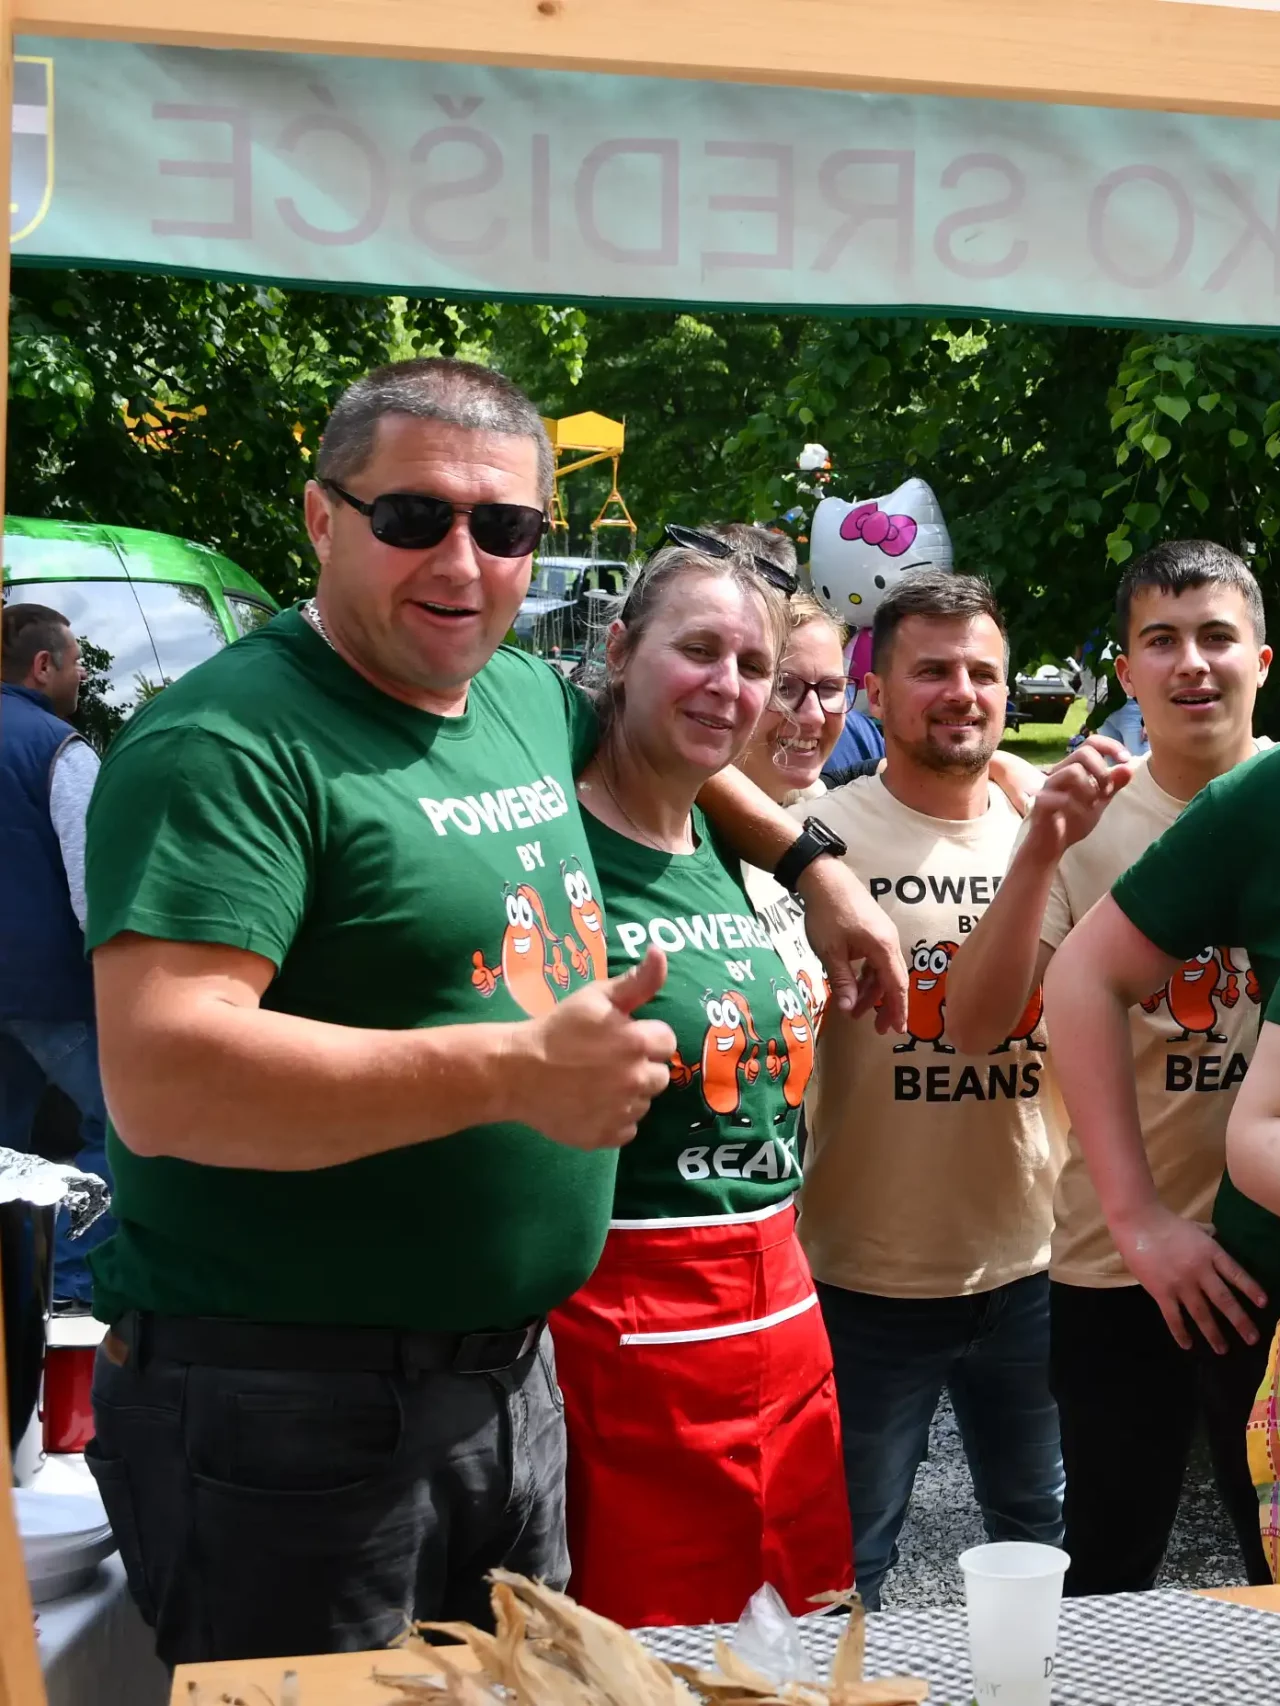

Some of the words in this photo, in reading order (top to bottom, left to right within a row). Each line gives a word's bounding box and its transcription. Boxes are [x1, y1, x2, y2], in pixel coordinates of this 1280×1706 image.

[418, 775, 569, 837] POWERED
[516, 841, 546, 872] BY
[869, 874, 1004, 905] POWE
[616, 913, 775, 959] POWERE
[724, 959, 756, 982] BY
[894, 1062, 1042, 1102] BEANS
[1165, 1052, 1249, 1092] BEA
